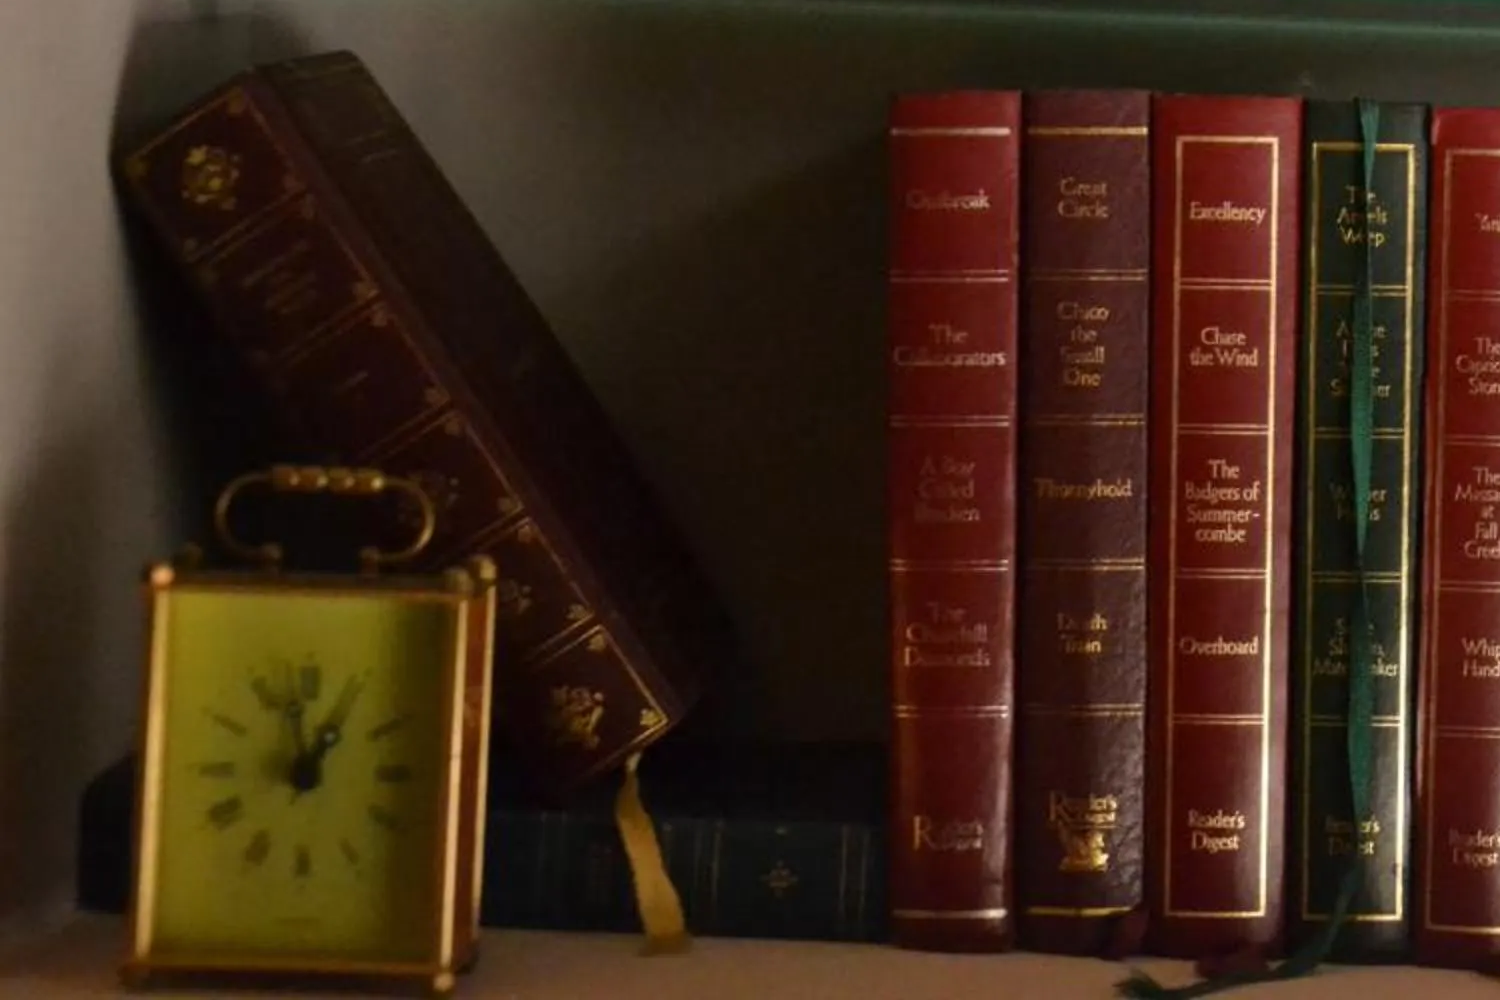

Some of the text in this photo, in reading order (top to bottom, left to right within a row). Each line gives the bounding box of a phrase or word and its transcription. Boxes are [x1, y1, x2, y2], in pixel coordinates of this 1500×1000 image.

[1059, 177, 1108, 197] Great
[1344, 184, 1377, 205] Te
[1057, 200, 1109, 218] Circle
[1189, 200, 1267, 226] Excellency
[928, 323, 969, 345] The
[1200, 326, 1247, 346] Chase
[1189, 347, 1259, 367] the Wind
[1062, 368, 1102, 387] One
[1208, 458, 1241, 479] The
[1184, 480, 1262, 505] Badgers of
[1186, 505, 1260, 524] Summer-
[1195, 524, 1248, 544] combe
[1475, 522, 1498, 540] Fall
[1178, 635, 1260, 656] Overboard
[1187, 809, 1245, 829] Reader's
[1190, 832, 1241, 853] Digest
